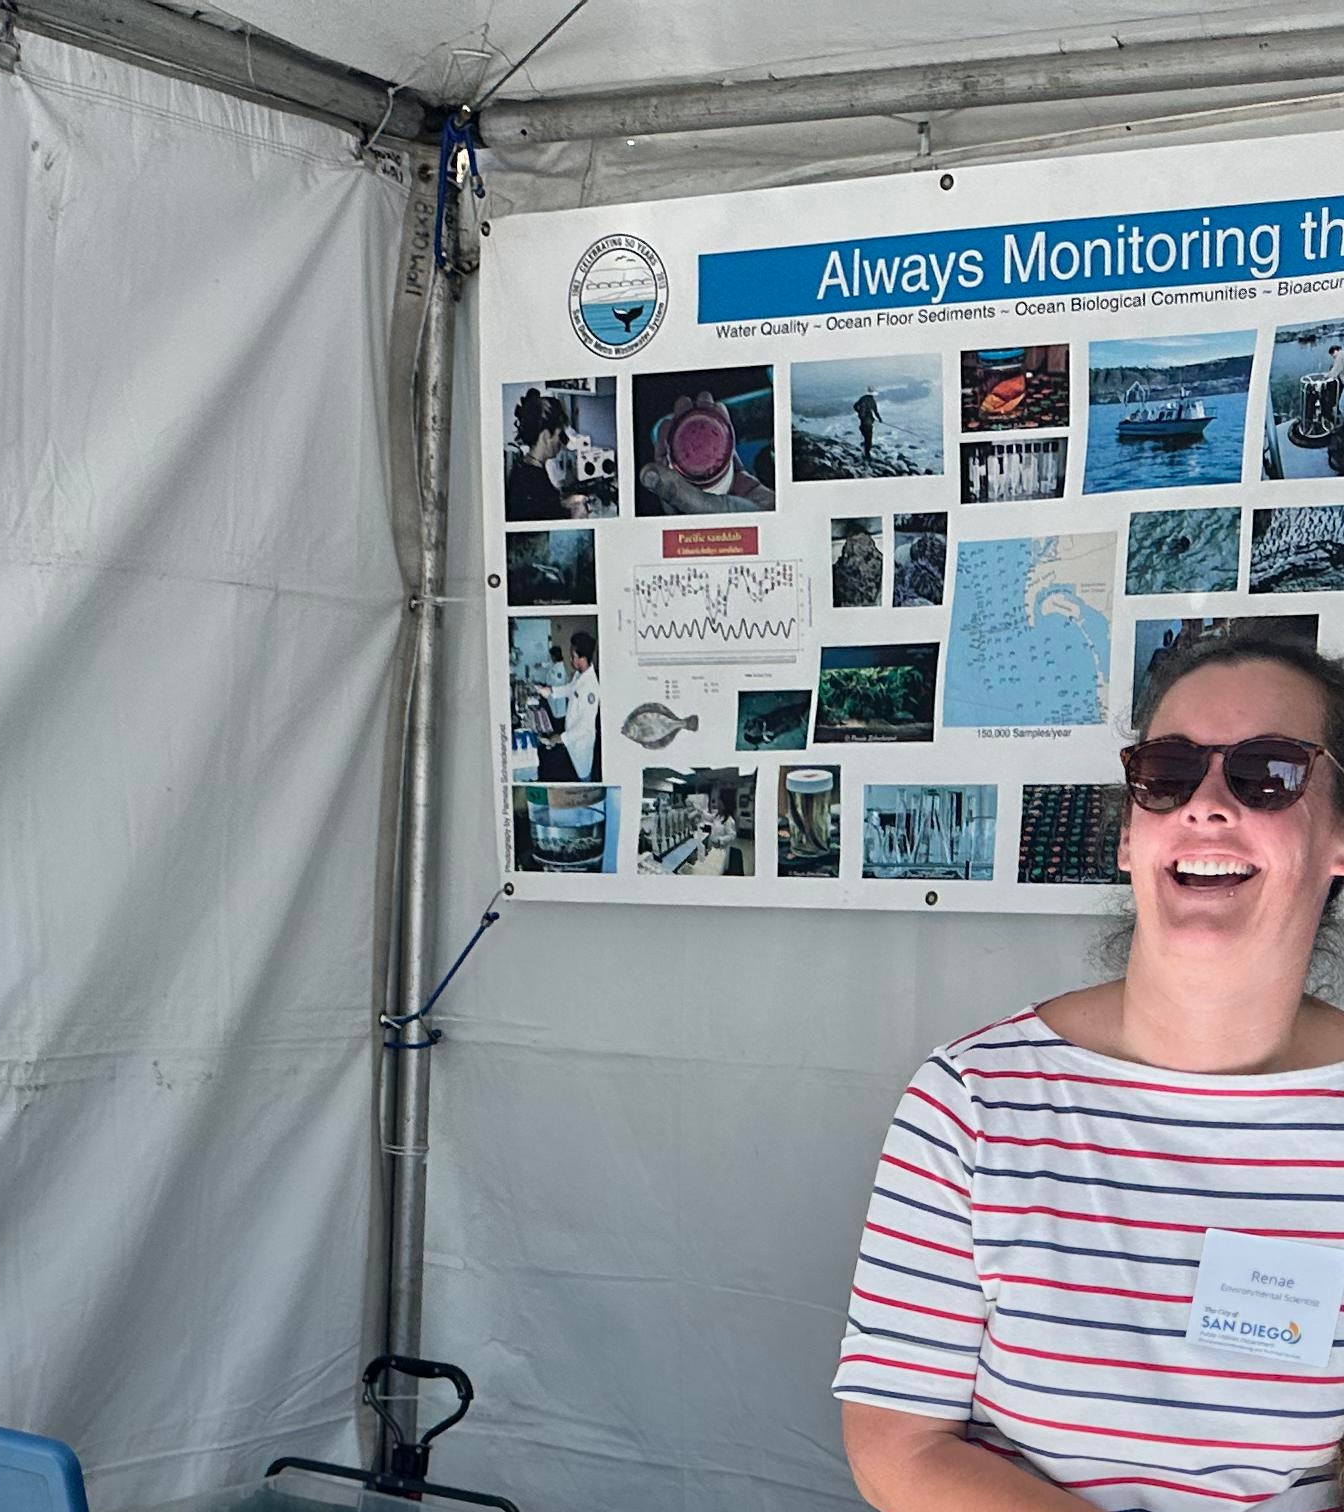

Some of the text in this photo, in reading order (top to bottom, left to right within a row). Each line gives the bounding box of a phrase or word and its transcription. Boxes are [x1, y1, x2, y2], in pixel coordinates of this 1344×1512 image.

[816, 248, 984, 304] Always
[1003, 217, 1280, 284] Monitoring
[717, 322, 756, 340] Water
[761, 319, 809, 338] Quality
[826, 313, 872, 331] Ocean
[876, 309, 913, 328] Floor
[918, 304, 995, 325] Sediments
[1015, 297, 1067, 317] Ocean
[1071, 290, 1146, 314] Biological
[1151, 284, 1257, 307] Communities
[1251, 1271, 1295, 1288] Renae
[1202, 1316, 1293, 1343] SAN DIEGO
